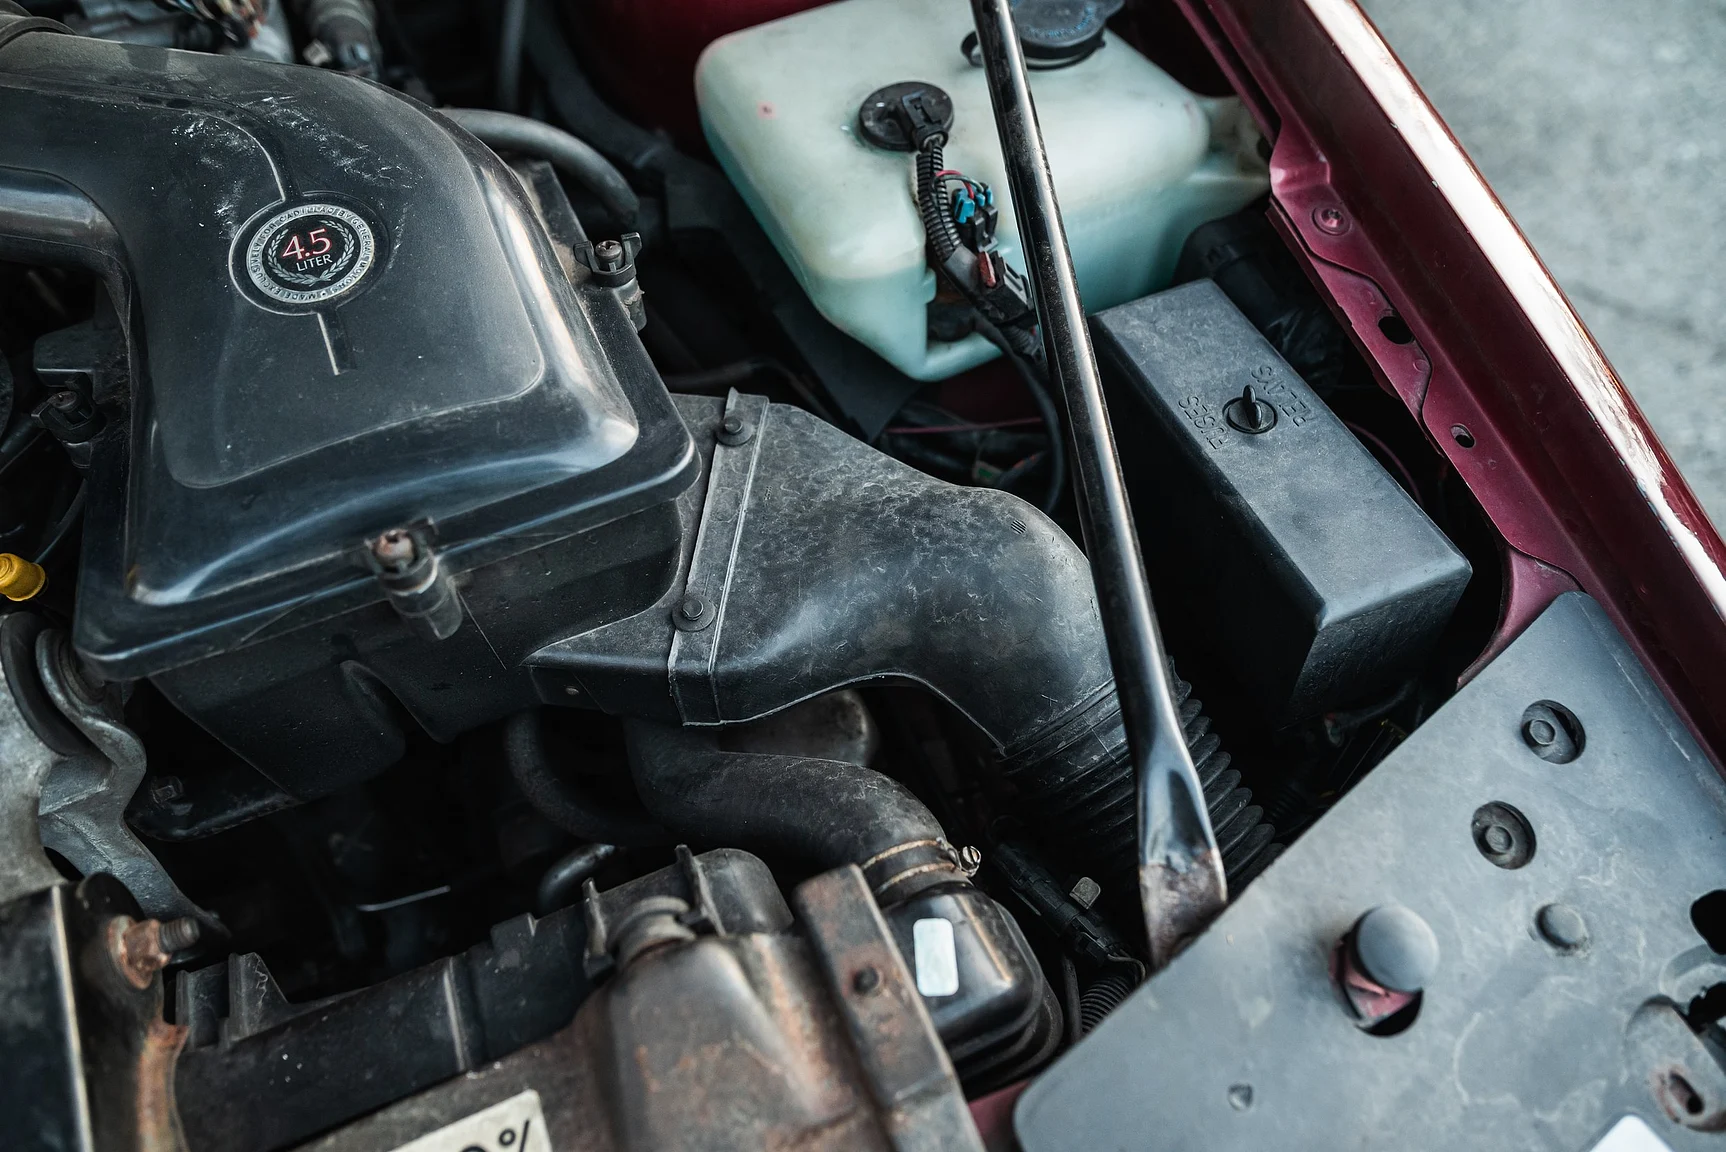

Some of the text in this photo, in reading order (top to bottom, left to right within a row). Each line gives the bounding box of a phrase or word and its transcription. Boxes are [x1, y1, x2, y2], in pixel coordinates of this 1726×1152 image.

[250, 206, 372, 300] MADE EXCLUSIVELY FOR CADILLAC BY GENERAL MOTORS
[282, 227, 333, 260] 4.5
[296, 254, 333, 272] LITER
[1178, 395, 1232, 450] FUSES
[1251, 365, 1317, 427] RELAYS
